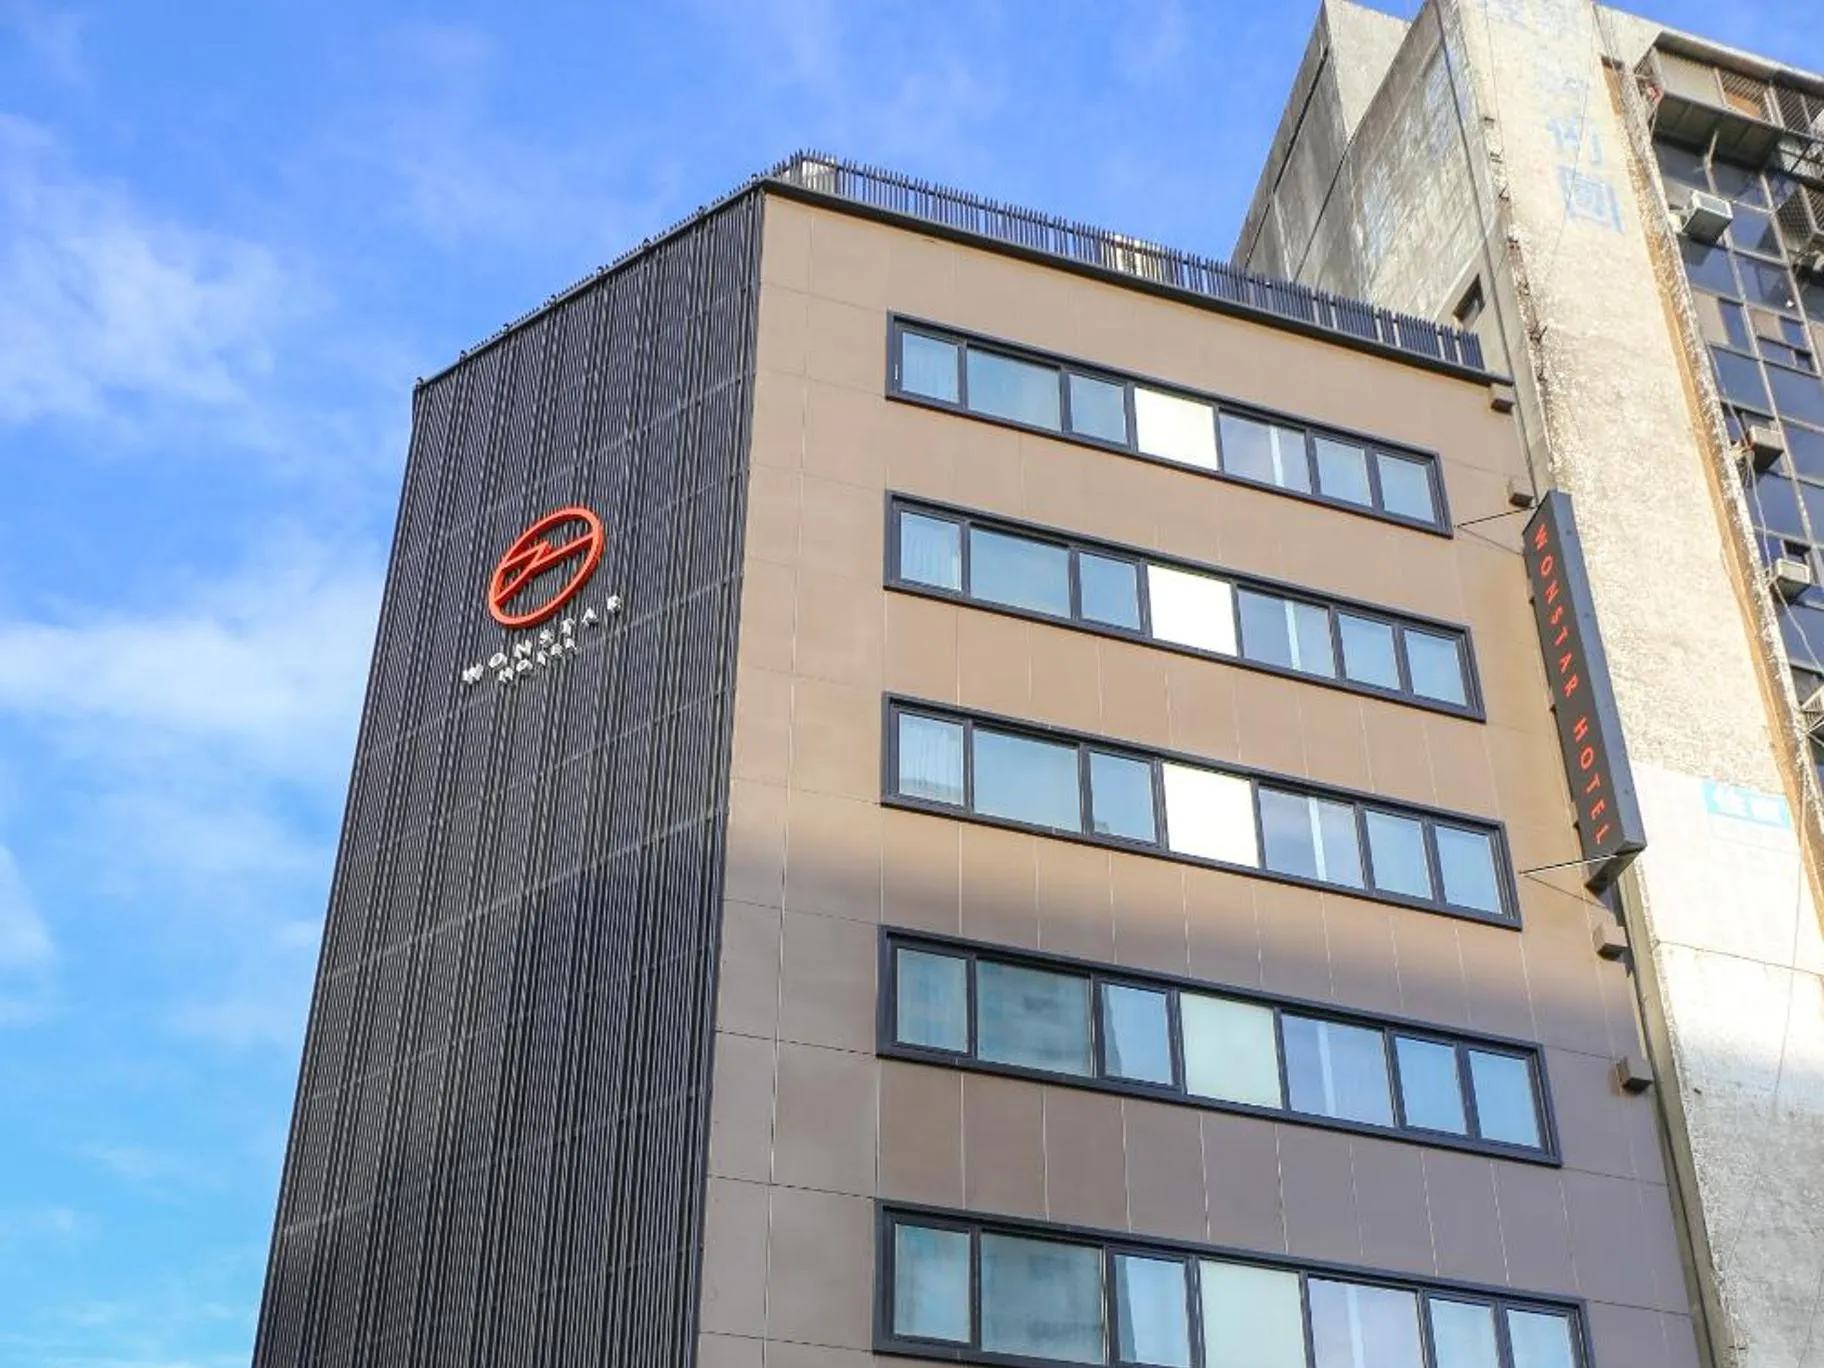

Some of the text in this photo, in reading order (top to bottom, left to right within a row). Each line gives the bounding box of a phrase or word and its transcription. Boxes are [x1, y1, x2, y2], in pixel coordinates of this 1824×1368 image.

[462, 594, 622, 684] WONSTAR
[1533, 523, 1610, 845] WONSTAR HOTEL
